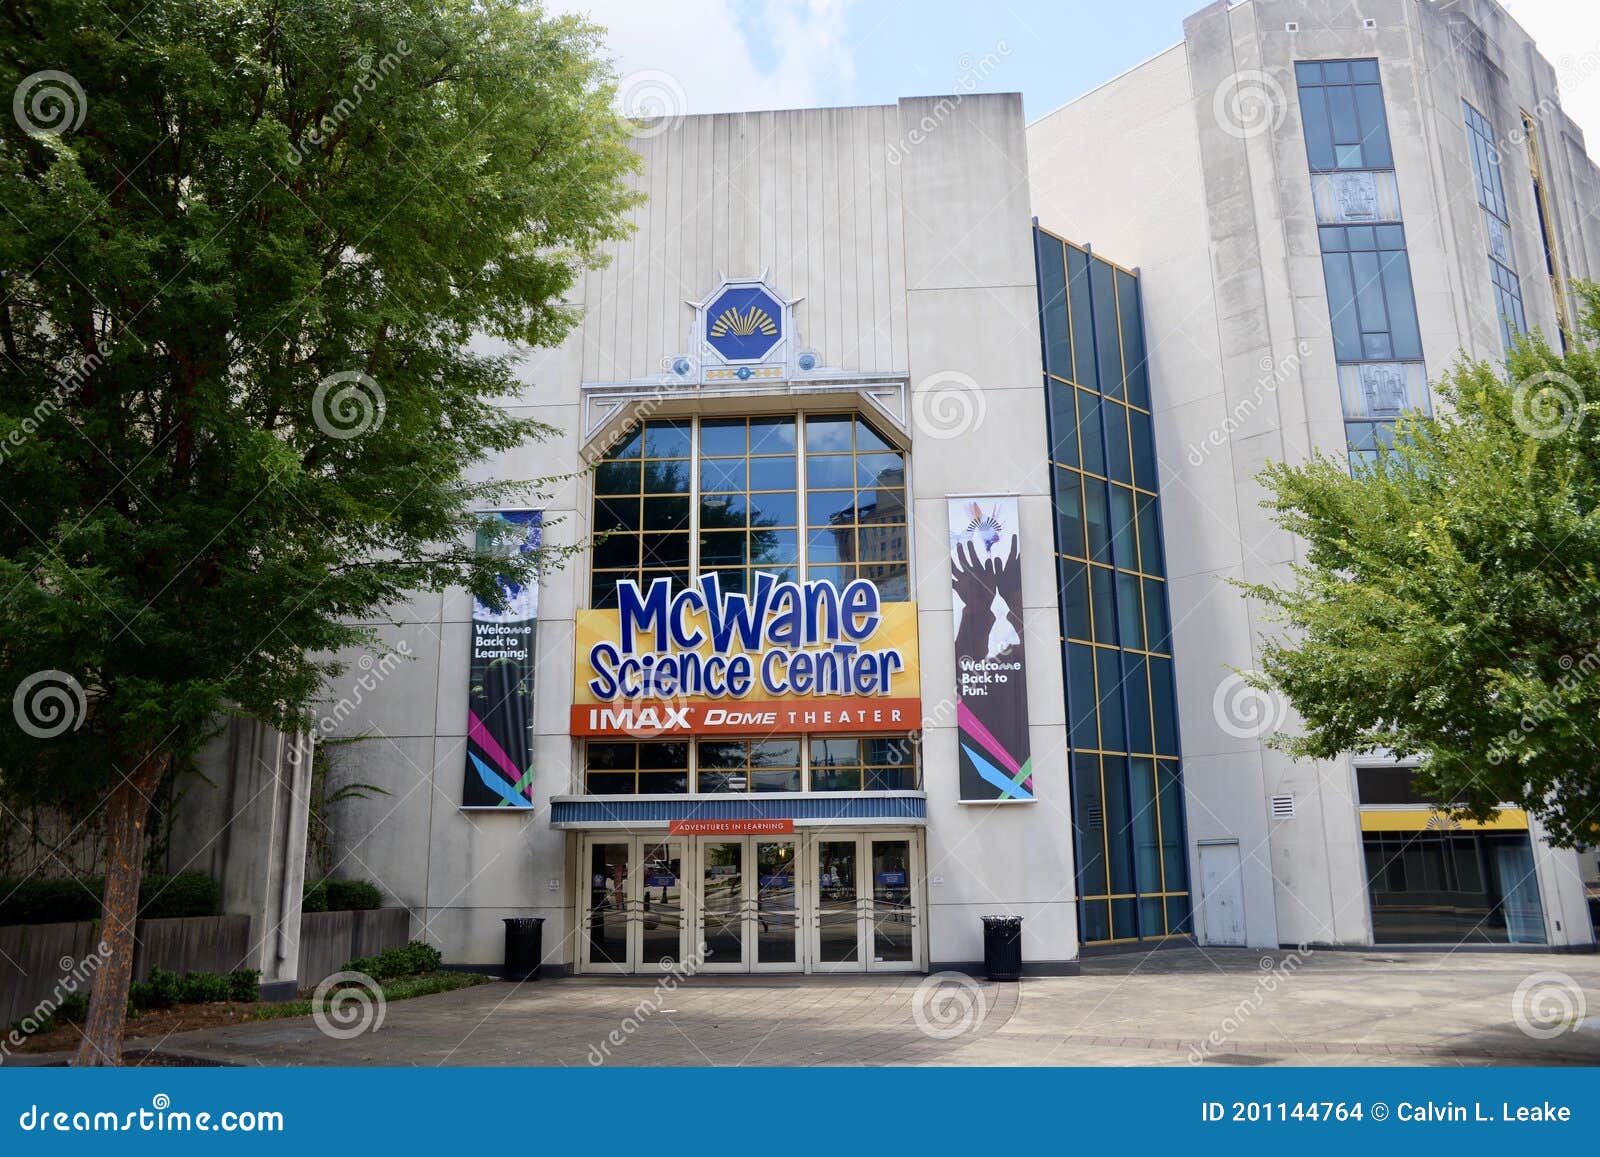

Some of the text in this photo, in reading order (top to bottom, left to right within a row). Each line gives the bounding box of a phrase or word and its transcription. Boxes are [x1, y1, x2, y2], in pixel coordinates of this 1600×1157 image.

[616, 571, 881, 655] McWane
[475, 624, 532, 635] Welcome
[475, 635, 518, 647] Back to
[475, 647, 528, 661] Learning!
[590, 643, 752, 699] Science
[961, 659, 1021, 671] Welcome
[962, 671, 1008, 684] Back to
[962, 685, 988, 696] Fun!
[787, 709, 902, 724] THEATER
[679, 823, 729, 831] ADVENTURES
[743, 822, 784, 830] LEARNING
